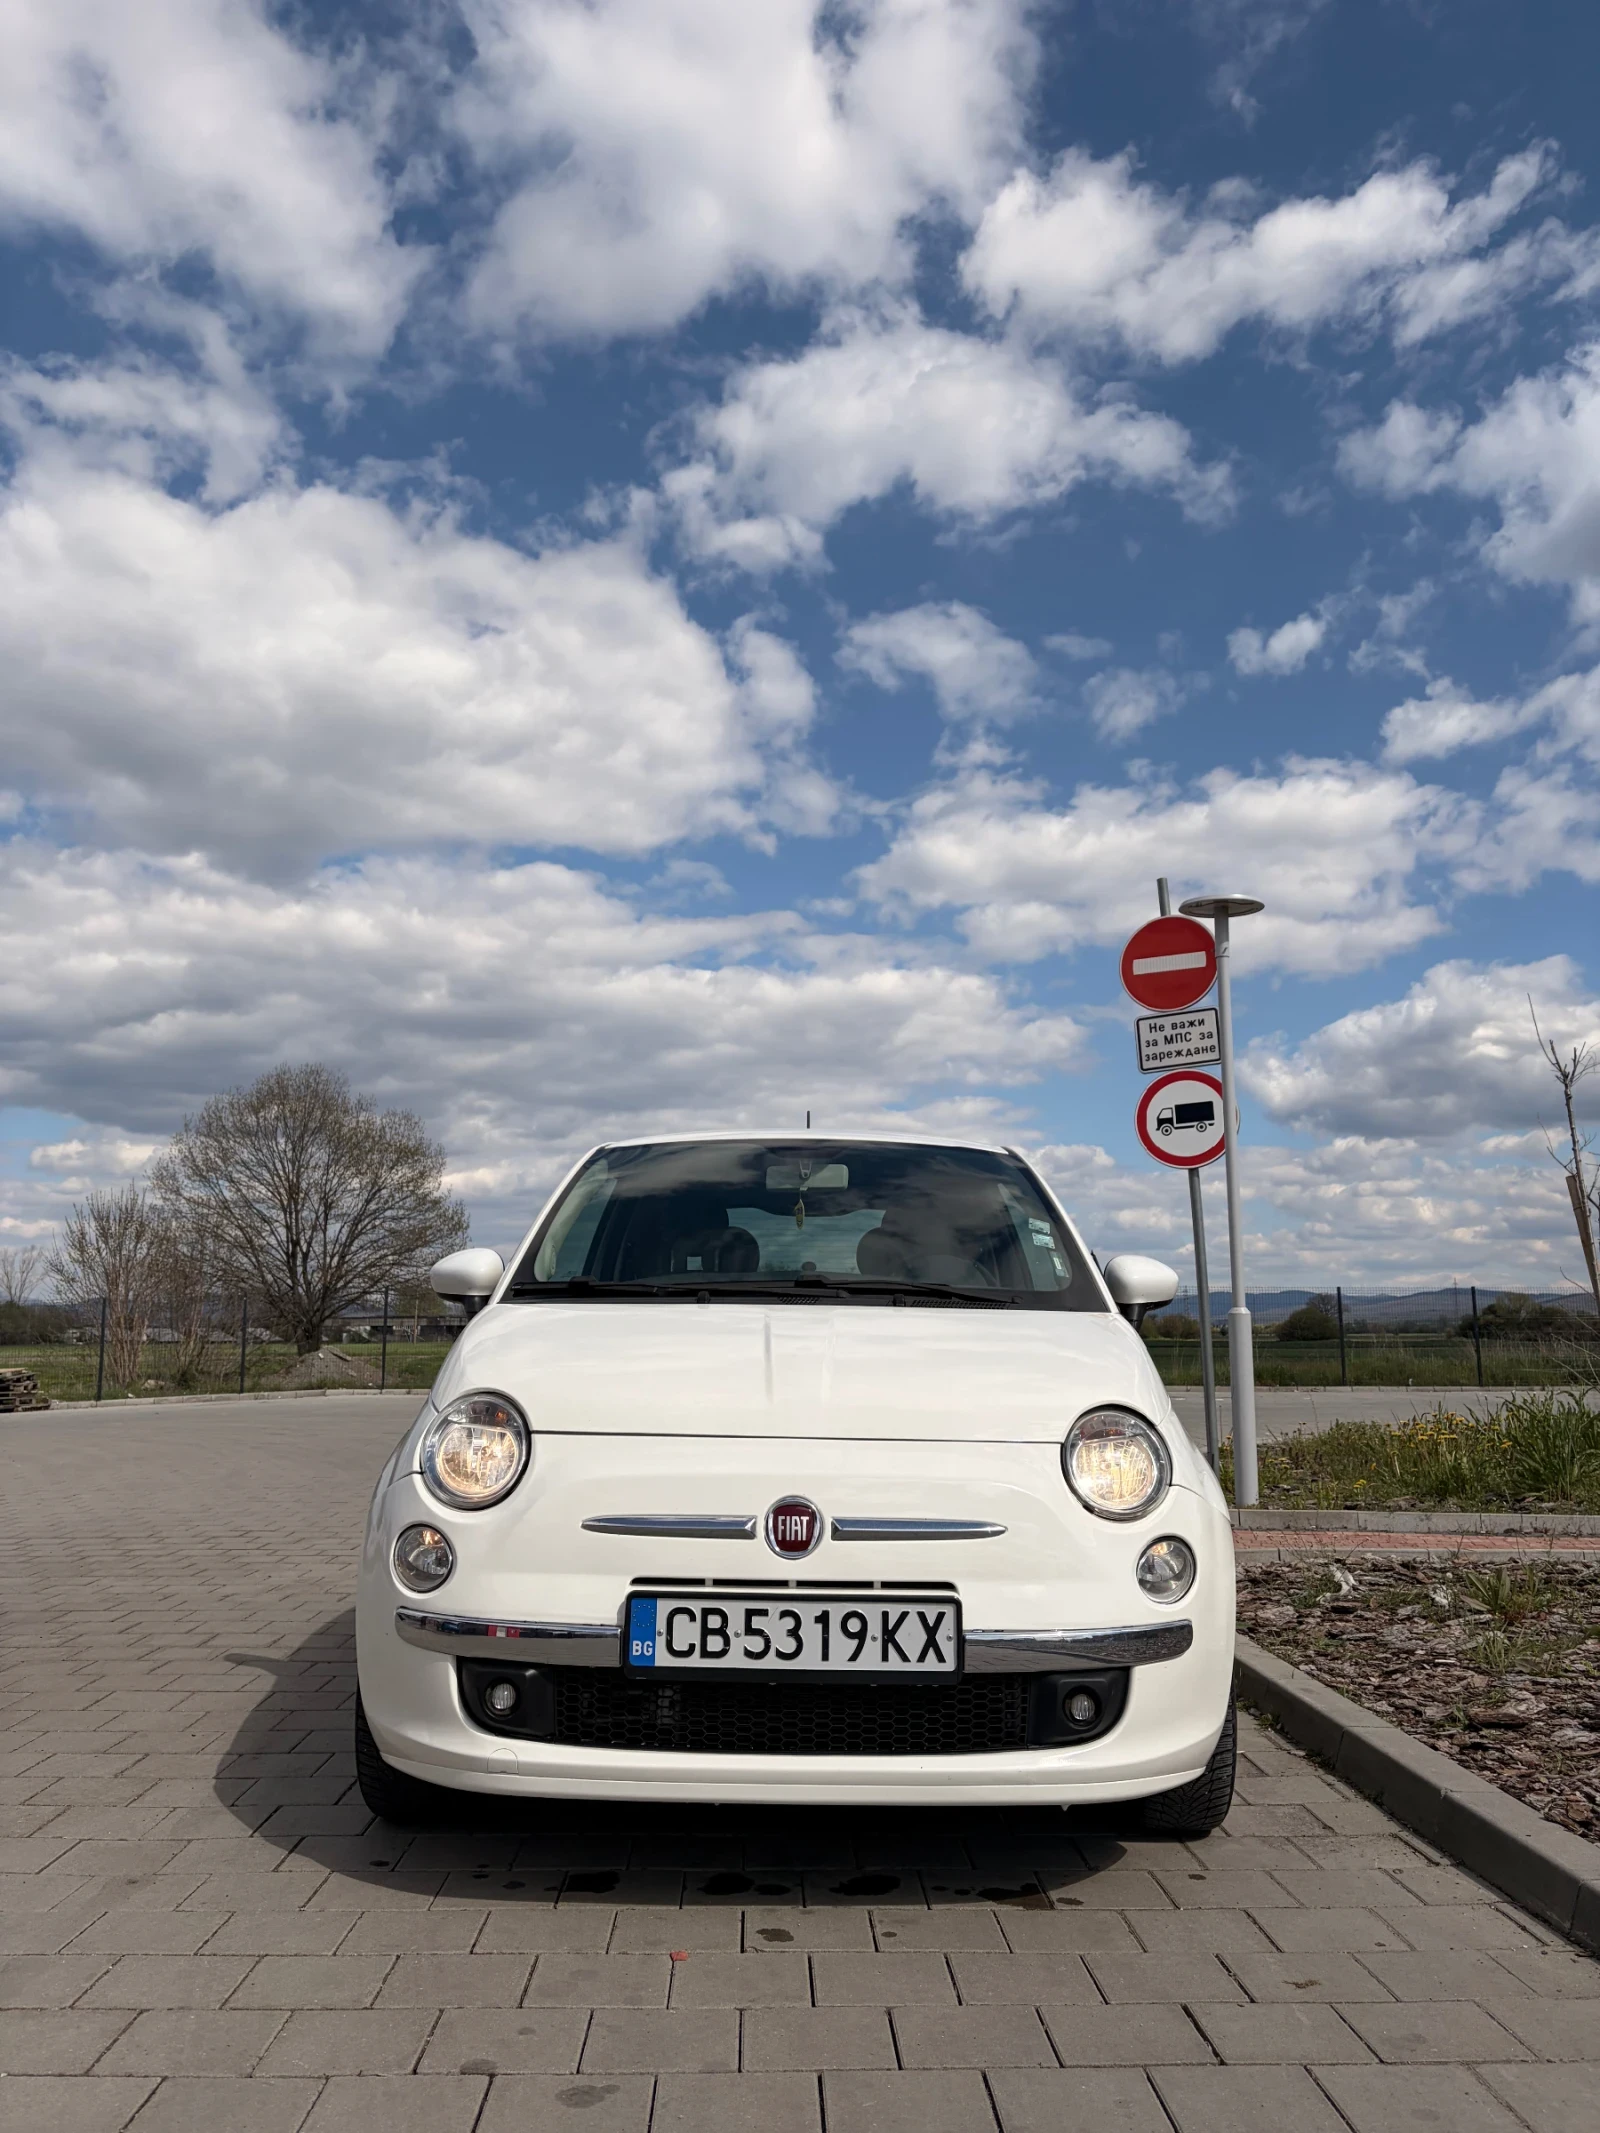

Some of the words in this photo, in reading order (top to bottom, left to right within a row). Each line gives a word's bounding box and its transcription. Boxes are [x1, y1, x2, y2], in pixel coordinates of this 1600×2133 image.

[1149, 1022, 1165, 1033] Не
[1171, 1018, 1205, 1030] важи
[1145, 1039, 1158, 1048] за
[1164, 1031, 1192, 1045] МПС
[1199, 1031, 1213, 1040] за
[1144, 1044, 1216, 1062] зареждане
[778, 1515, 809, 1541] FIAT
[632, 1640, 653, 1656] BG
